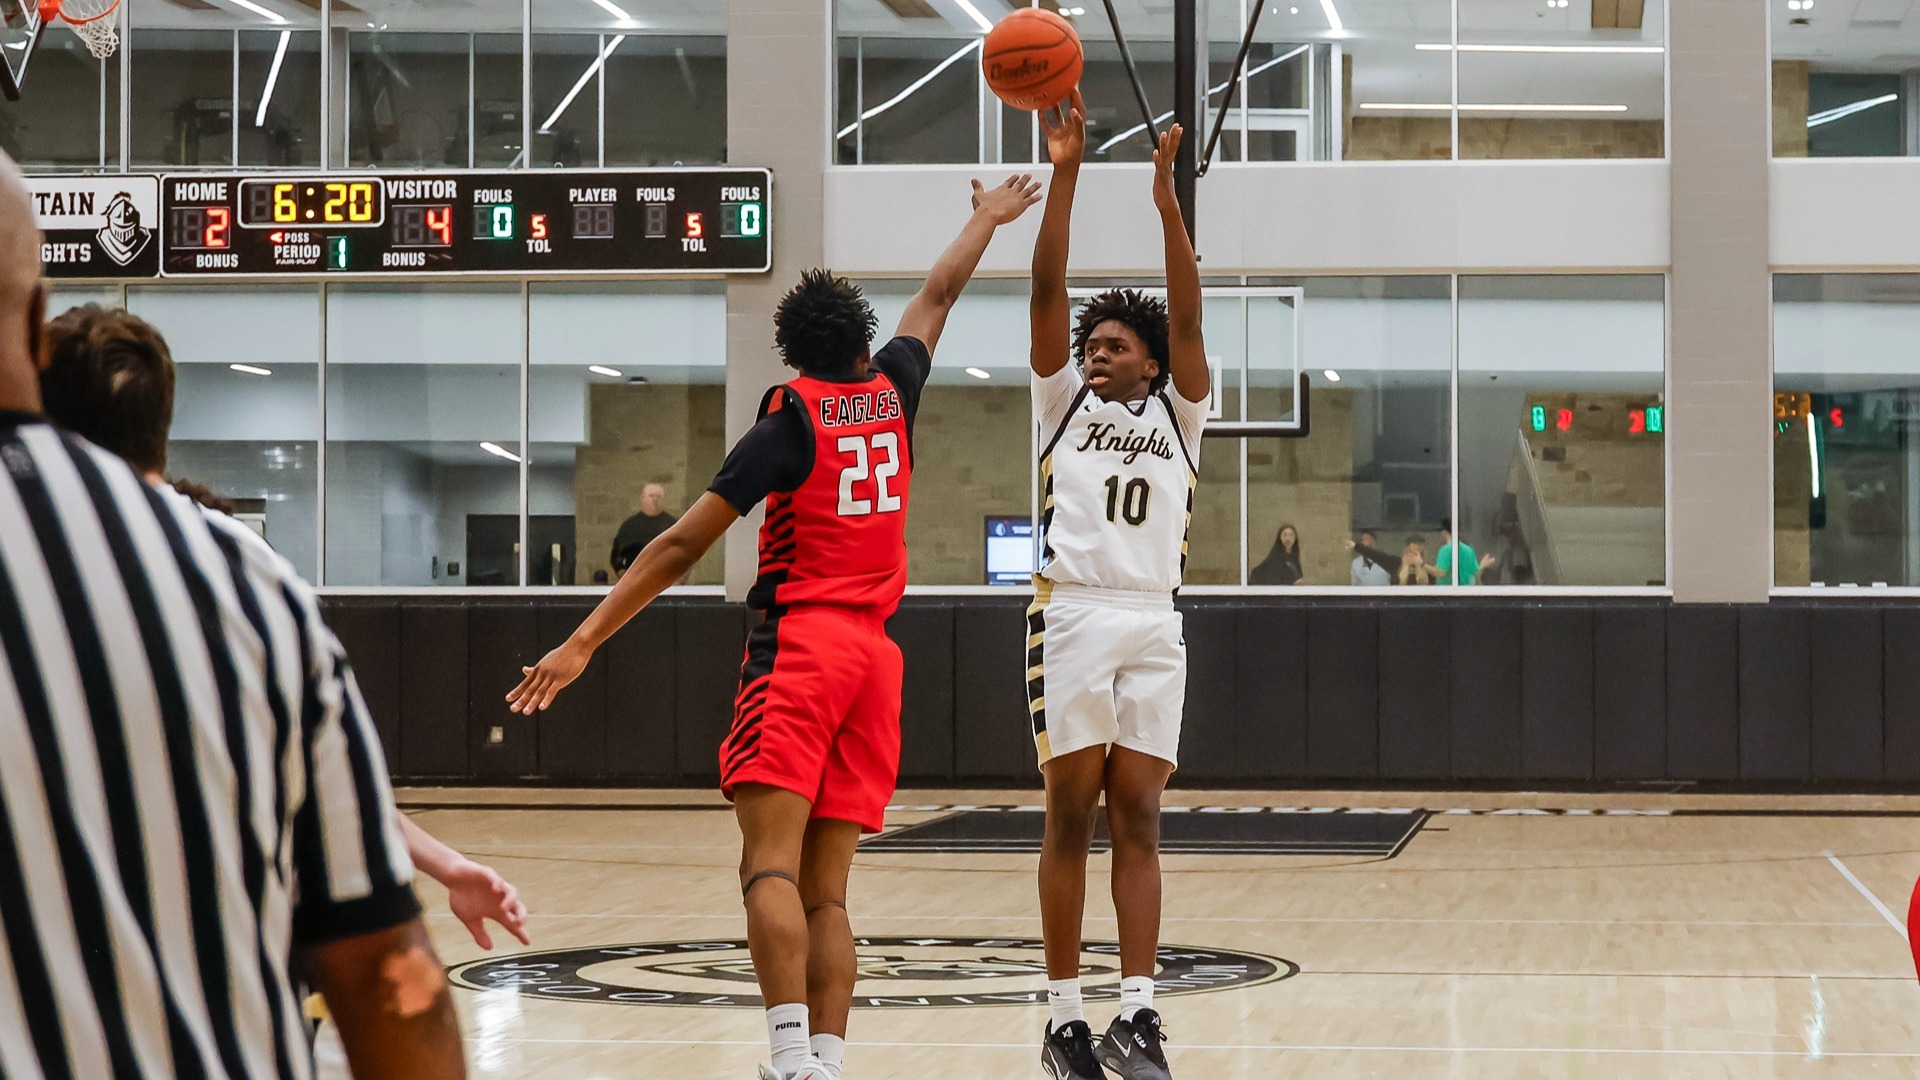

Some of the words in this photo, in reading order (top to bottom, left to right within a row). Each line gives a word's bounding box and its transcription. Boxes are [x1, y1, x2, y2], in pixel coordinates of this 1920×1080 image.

[175, 182, 227, 201] HOME
[386, 180, 457, 199] VISITOR
[473, 189, 513, 204] FOULS
[569, 188, 617, 202] PLAYER
[636, 187, 676, 202] FOULS
[720, 186, 760, 201] FOULS
[29, 191, 95, 216] TAIN
[273, 183, 372, 222] 6:20
[204, 208, 229, 247] 2
[427, 206, 452, 245] 4
[492, 205, 513, 238] 0
[740, 203, 760, 237] 0
[284, 232, 310, 243] POSS
[526, 239, 551, 253] TOL
[681, 238, 706, 252] TOL
[40, 242, 91, 263] GHTS
[195, 253, 238, 268] BONUS
[274, 245, 321, 259] PERIOD
[338, 238, 347, 269] 1
[382, 252, 426, 267] BONUS
[820, 389, 901, 427] EAGLES
[1076, 421, 1173, 465] Knights
[836, 430, 902, 517] 22
[1104, 475, 1153, 528] 10
[775, 1021, 802, 1031] PUMA
